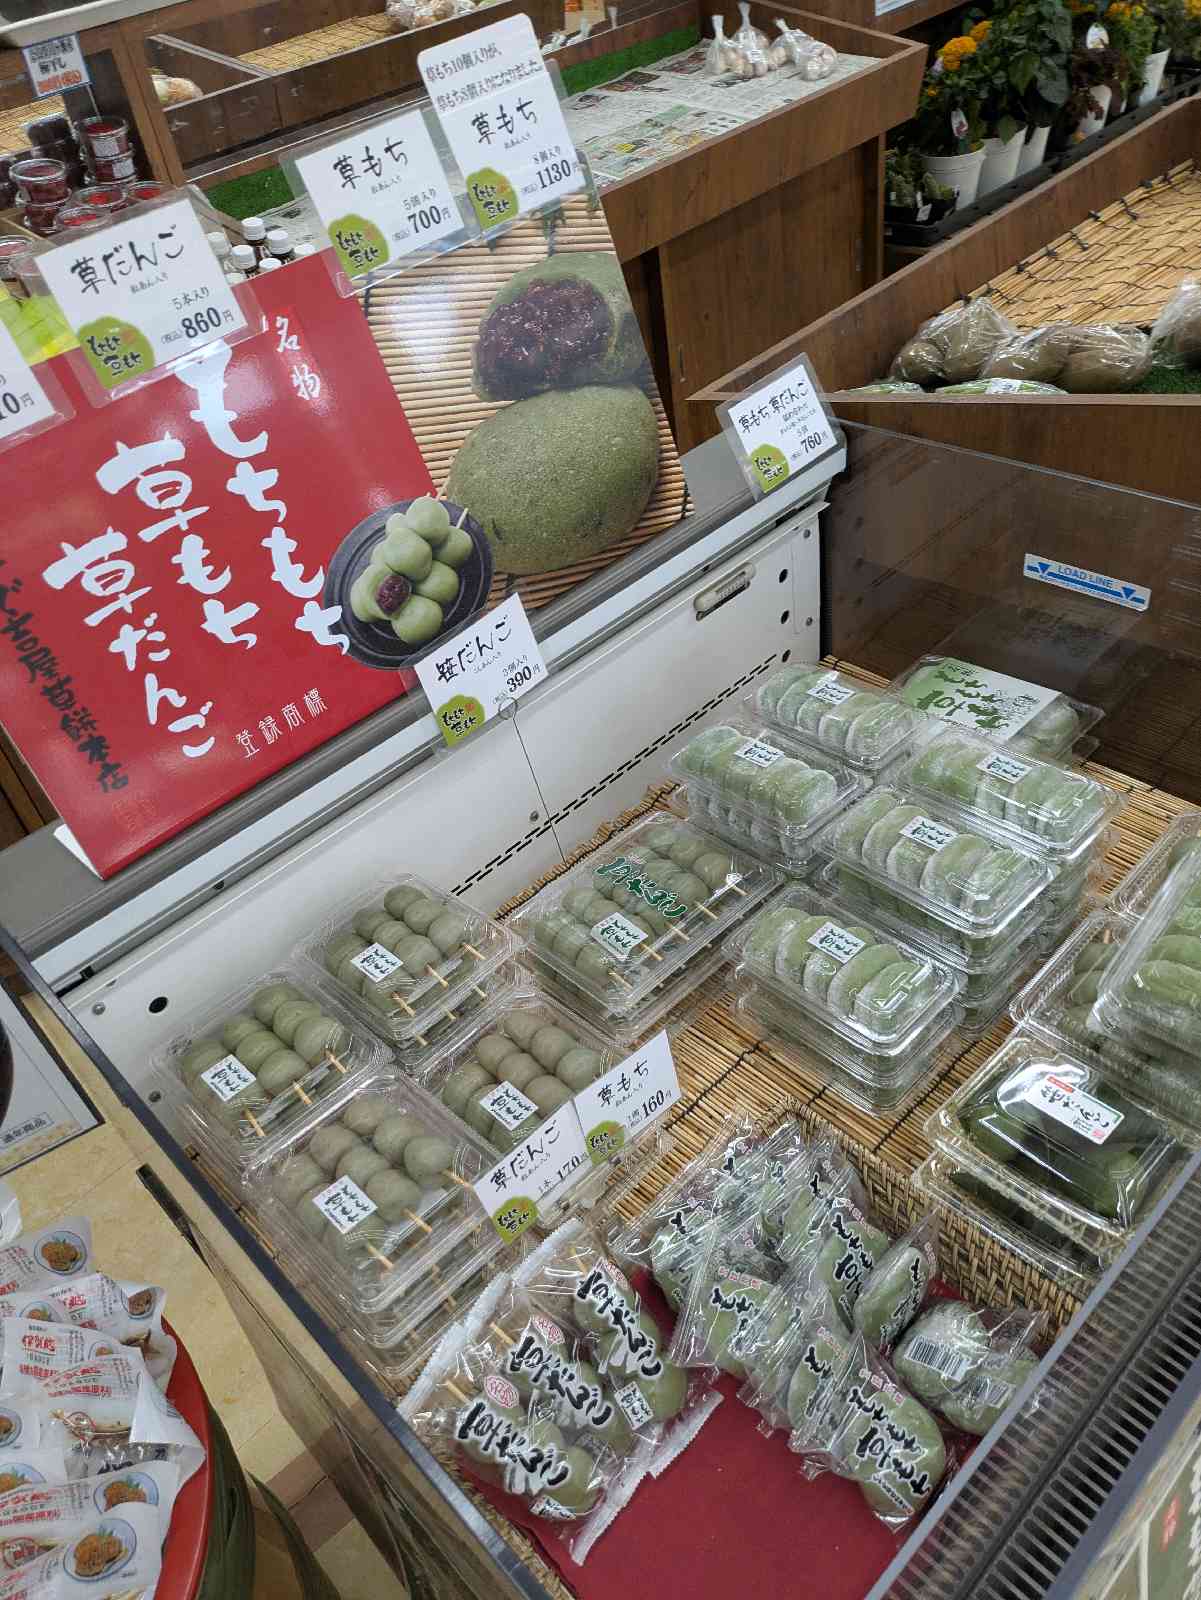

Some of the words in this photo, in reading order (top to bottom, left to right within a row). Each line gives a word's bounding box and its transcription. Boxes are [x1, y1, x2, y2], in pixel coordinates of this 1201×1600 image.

[471, 97, 538, 145] 草もち
[333, 137, 409, 190] 草もち
[402, 187, 437, 211] 5個入り
[70, 224, 185, 295] 草だんご
[172, 286, 210, 311] 5本入り
[275, 315, 322, 401] 名物
[175, 340, 349, 655] もちもち
[96, 430, 260, 650] 草もち
[1057, 565, 1088, 579] LOAD
[1088, 574, 1114, 588] LINE
[42, 526, 215, 758] 草だんご
[435, 614, 512, 683] 笹だんご
[235, 687, 328, 759] 登録商標
[598, 1059, 649, 1107] 草もち
[490, 1119, 560, 1192] 草だんご
[576, 1270, 662, 1377] 草だんご
[509, 1336, 612, 1426] 草だんご
[458, 1402, 569, 1486] 草だんご
[848, 1388, 922, 1453] もちもち
[855, 1426, 932, 1494] 草もち
